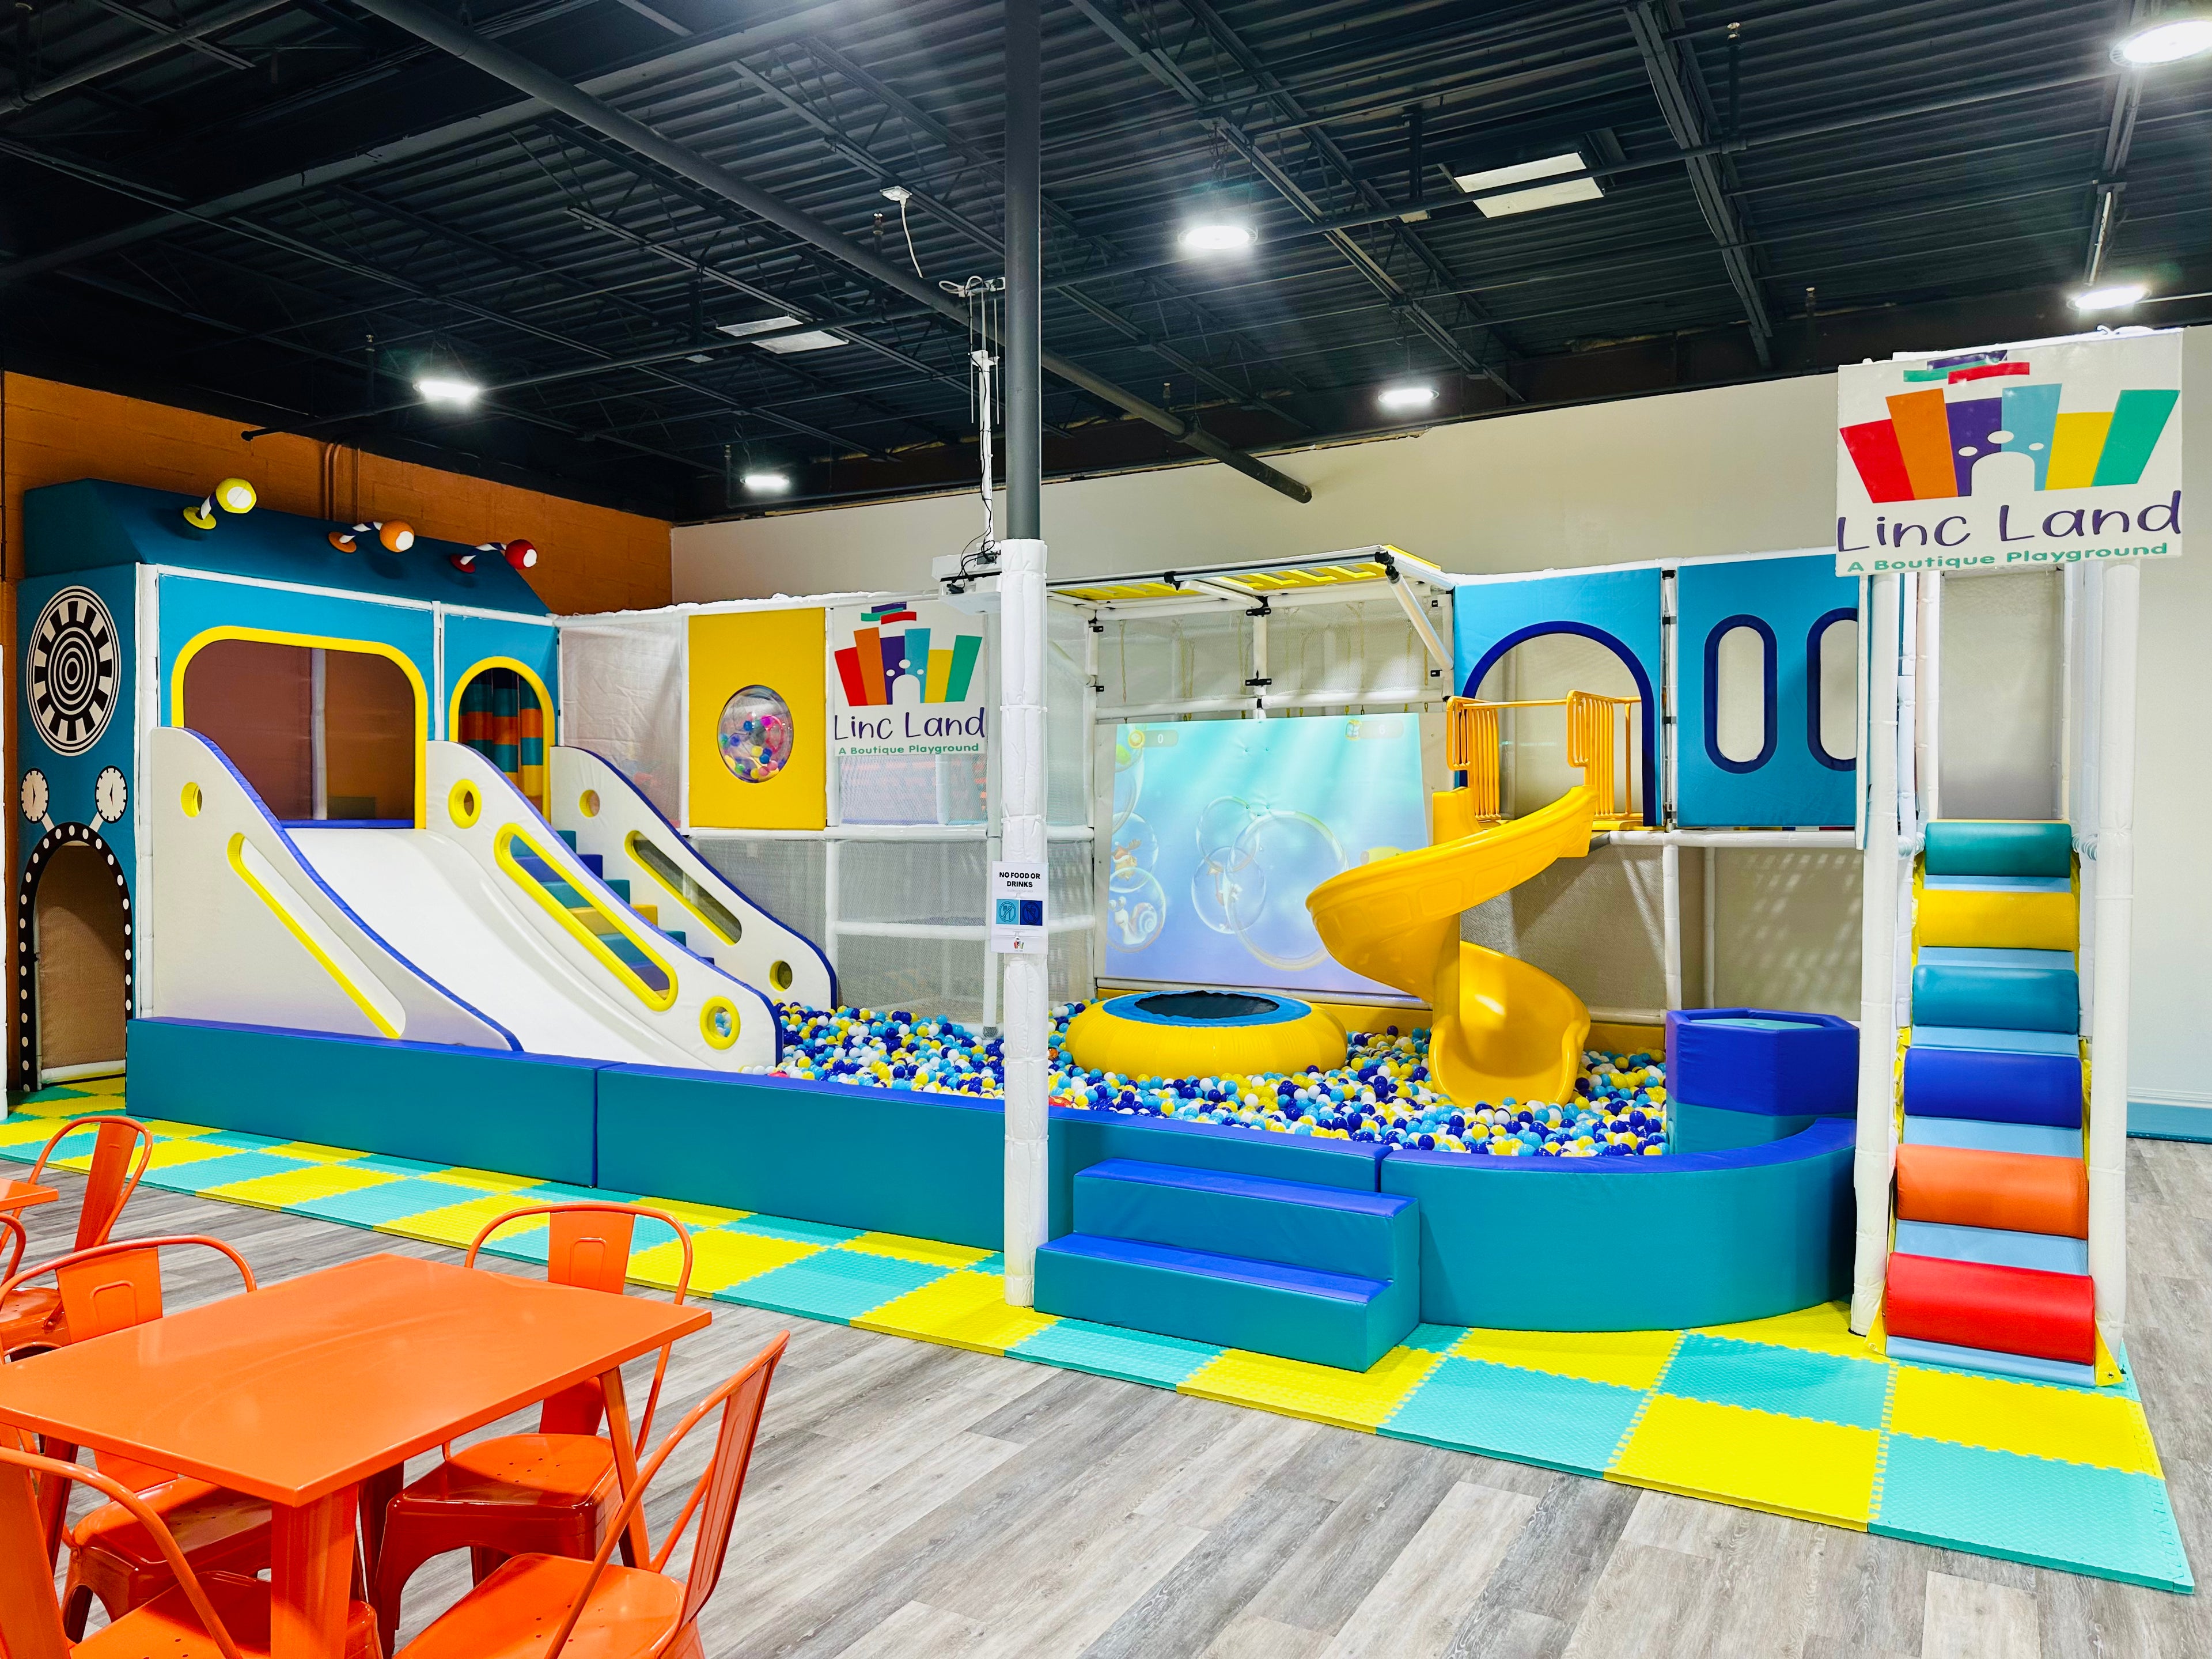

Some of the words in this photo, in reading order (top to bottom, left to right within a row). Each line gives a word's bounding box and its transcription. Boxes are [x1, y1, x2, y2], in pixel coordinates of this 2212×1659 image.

[1837, 516, 1971, 552] Linc
[1999, 490, 2181, 541] Land
[1847, 561, 1865, 573] A
[1874, 555, 1995, 570] Boutique
[2006, 542, 2168, 563] Playground
[834, 714, 893, 740] Linc
[905, 706, 986, 738] Land
[1157, 733, 1164, 744] 0
[838, 747, 847, 755] A
[851, 745, 905, 756] Boutique
[908, 743, 979, 755] Playground
